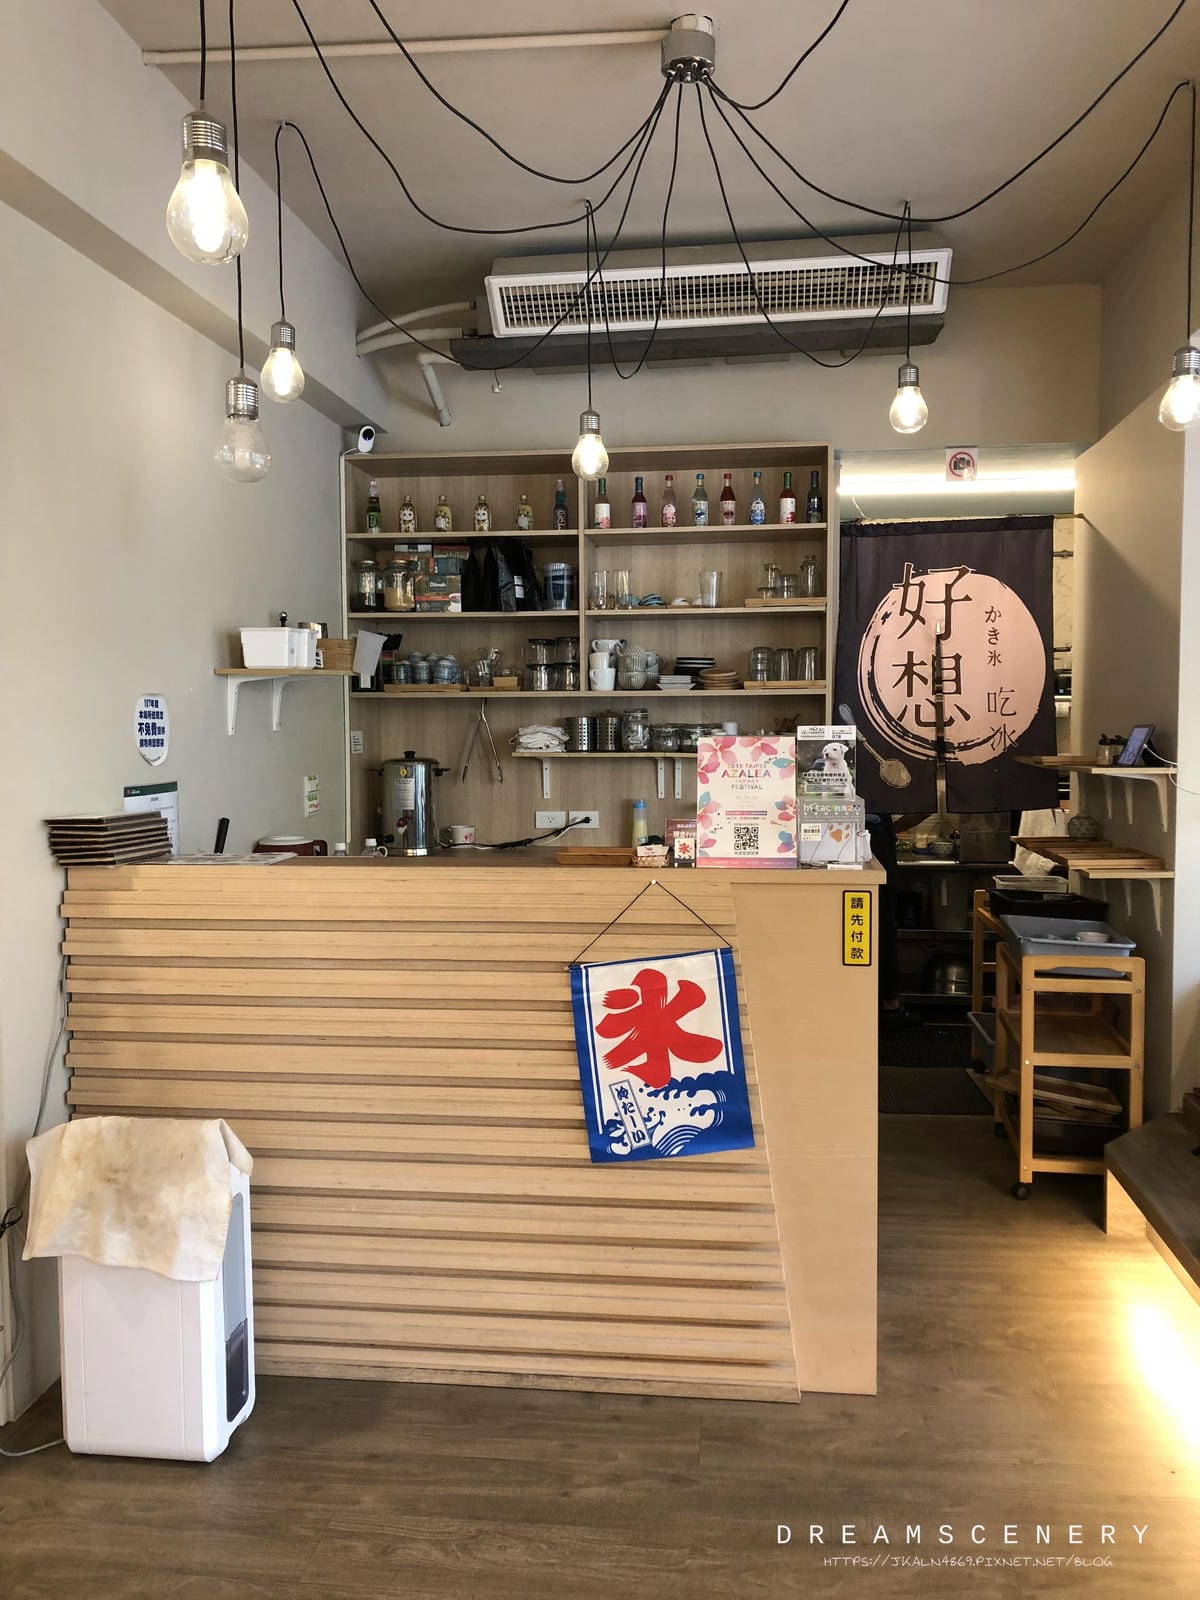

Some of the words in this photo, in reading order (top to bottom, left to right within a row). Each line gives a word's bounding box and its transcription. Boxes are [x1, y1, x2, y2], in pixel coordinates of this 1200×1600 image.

[892, 561, 973, 728] 好想
[984, 605, 1003, 667] かき氷
[721, 769, 772, 778] AZALEA
[850, 896, 864, 960] 請先付款
